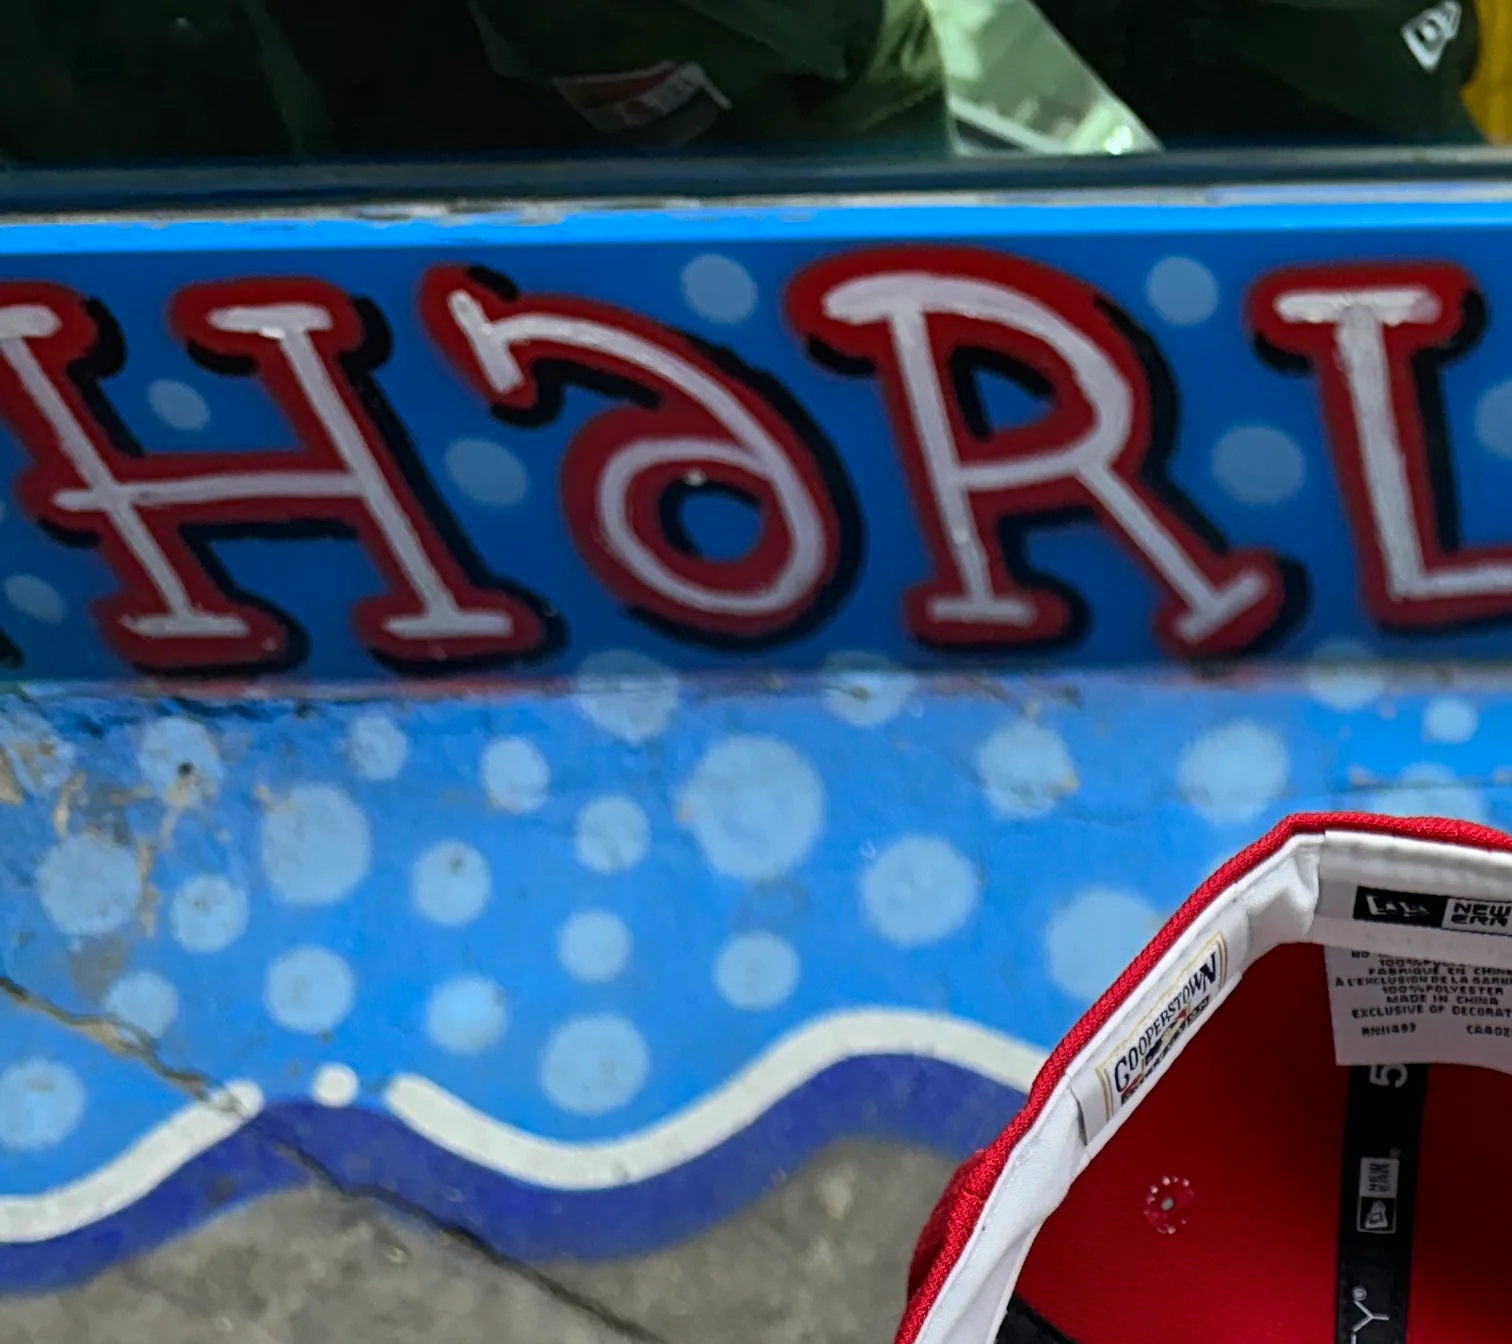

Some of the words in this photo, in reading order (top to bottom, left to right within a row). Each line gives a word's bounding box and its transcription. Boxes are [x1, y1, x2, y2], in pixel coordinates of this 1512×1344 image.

[1453, 902, 1512, 917] NEW
[1450, 914, 1509, 928] ERA
[1386, 995, 1427, 1003] MADE
[1433, 995, 1449, 1003] IN
[1456, 996, 1499, 1006] CHINA
[1352, 1004, 1424, 1019] EXCLUSIVE
[1429, 1005, 1445, 1014] OF
[1114, 951, 1217, 1094] COOPERSTOWN
